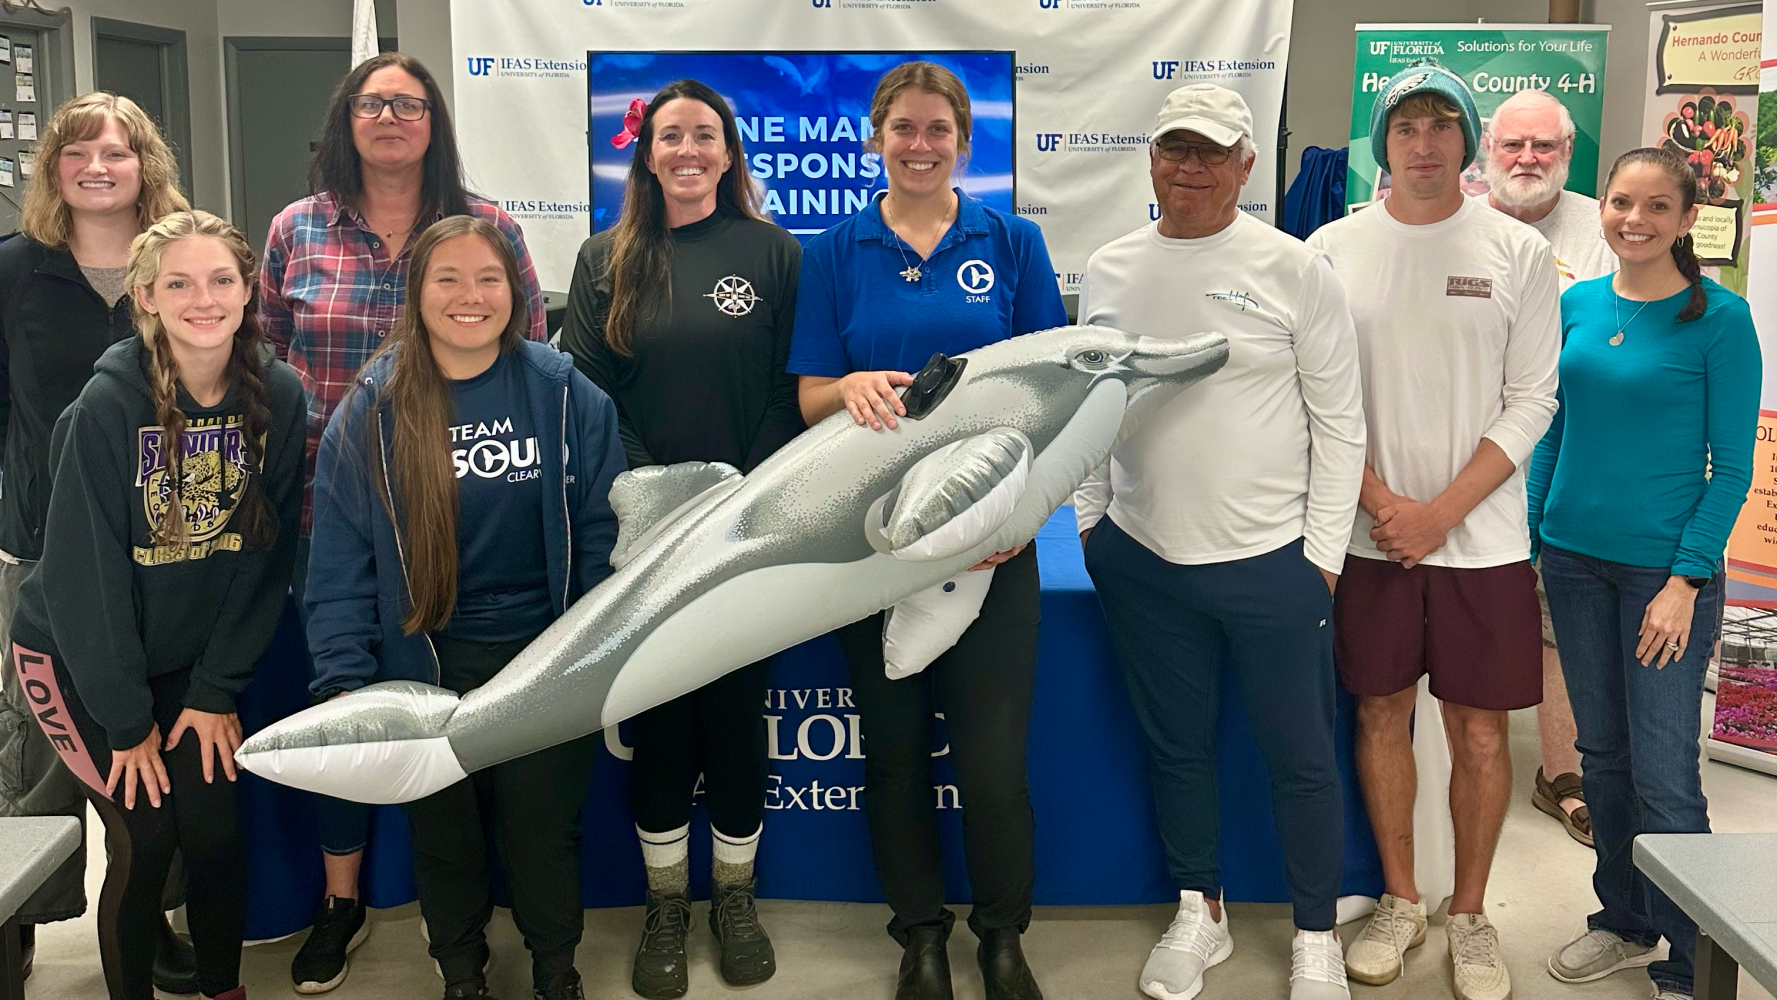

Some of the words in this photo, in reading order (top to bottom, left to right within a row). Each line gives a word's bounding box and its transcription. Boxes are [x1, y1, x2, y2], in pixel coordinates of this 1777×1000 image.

[1108, 2, 1115, 10] of
[1457, 40, 1515, 52] Solutions
[1518, 40, 1537, 52] for
[1538, 40, 1568, 52] Your
[1570, 40, 1593, 52] Life
[1672, 32, 1728, 47] Hernando
[1370, 41, 1391, 55] UF
[1393, 45, 1445, 55] FLORIDA
[1698, 51, 1707, 62] A
[467, 57, 495, 76] UF
[500, 58, 532, 69] IFAS
[535, 59, 587, 71] Extensio
[1152, 61, 1179, 80] UF
[1184, 60, 1215, 72] IFAS
[1218, 58, 1275, 71] Extension
[1473, 72, 1551, 93] County
[1557, 73, 1596, 94] 4-H
[1036, 133, 1063, 152] UF
[1068, 133, 1099, 145] IFAS
[1101, 133, 1152, 145] Extensio
[505, 200, 536, 212] IFAS
[538, 201, 590, 212] Extensio
[1715, 216, 1734, 225] locally
[1696, 232, 1718, 241] County
[1696, 242, 1726, 250] goodness!
[965, 295, 991, 304] STAFF
[448, 416, 514, 443] TEAM
[133, 545, 188, 566] CLASS
[188, 540, 211, 560] of
[19, 652, 78, 753] LOVE
